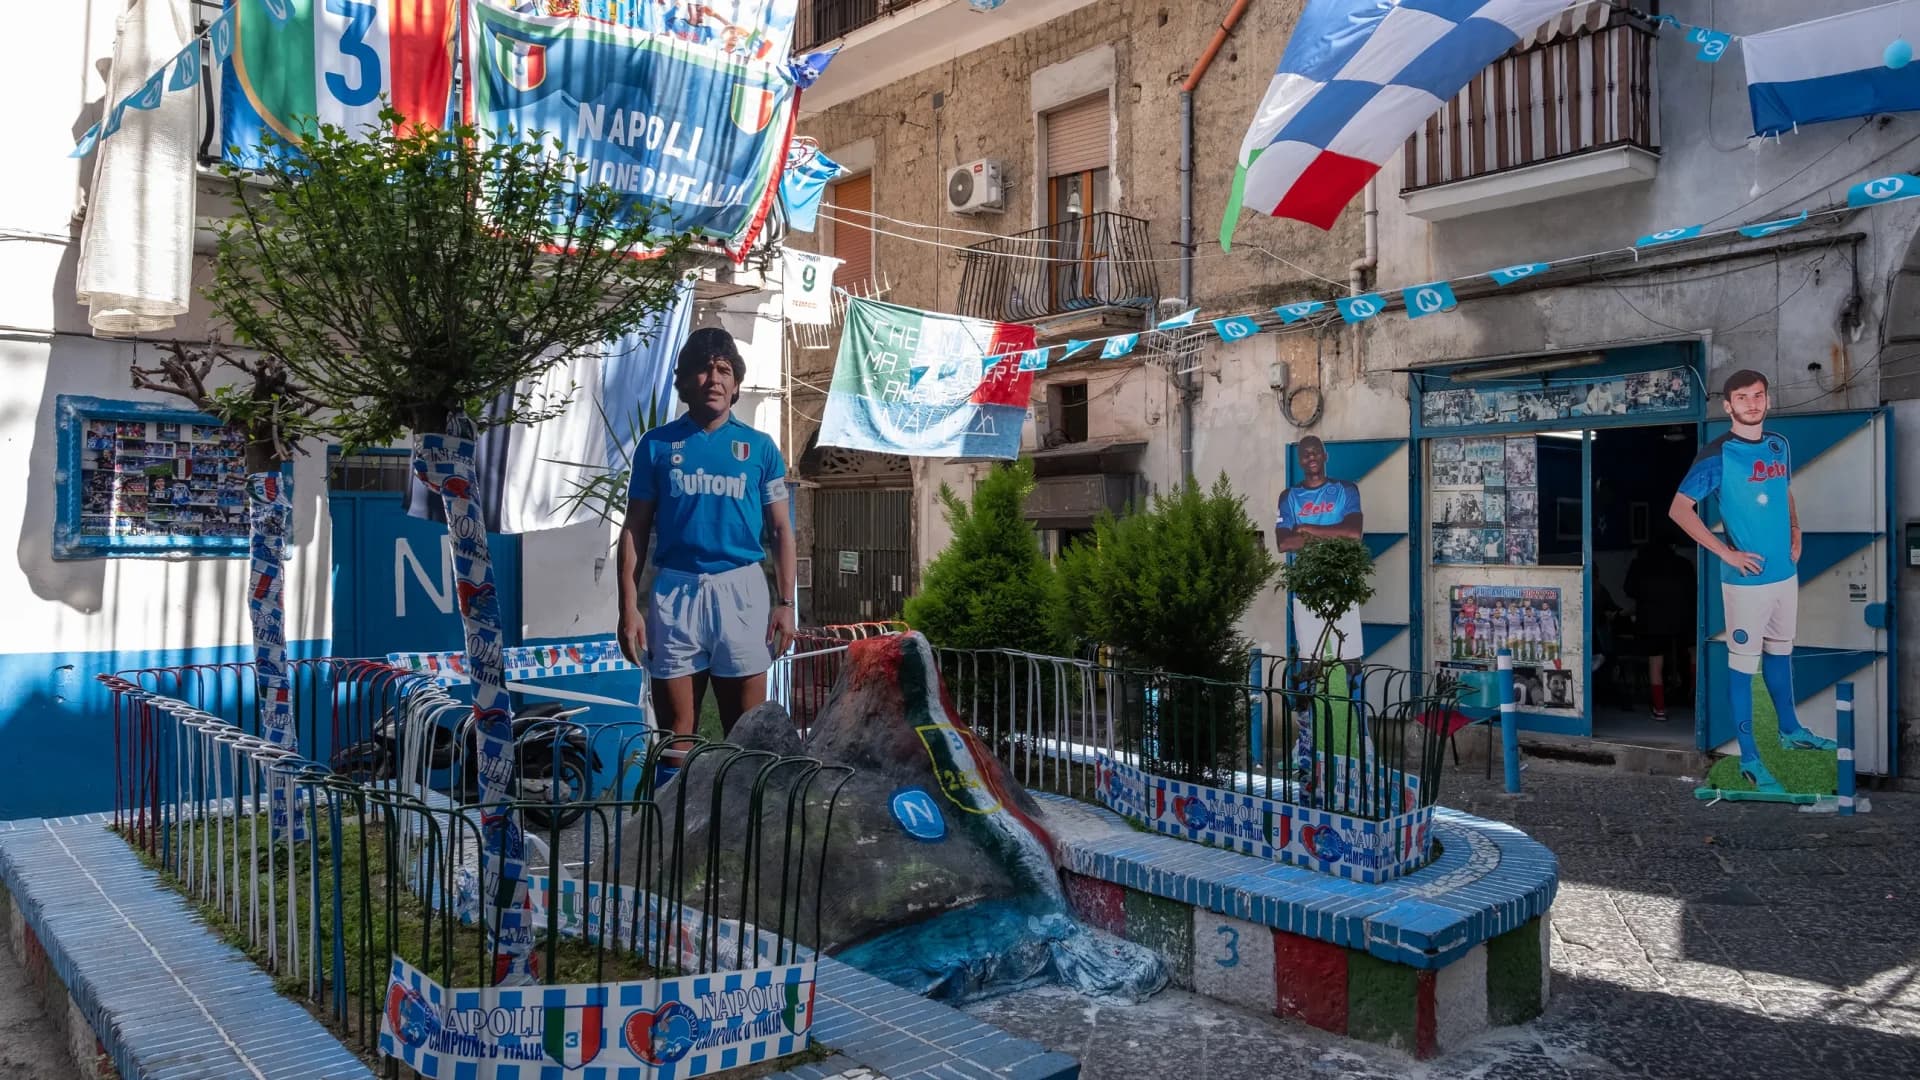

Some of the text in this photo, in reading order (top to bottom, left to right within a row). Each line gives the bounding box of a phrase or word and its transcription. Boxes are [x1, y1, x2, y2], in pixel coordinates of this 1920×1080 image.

[325, 0, 382, 107] 3
[577, 102, 704, 161] NAPOLI
[802, 265, 816, 292] 9
[1353, 301, 1373, 315] N
[1419, 290, 1439, 309] N
[872, 320, 919, 351] CHE
[1228, 323, 1246, 336] N
[864, 351, 897, 374] MA
[395, 534, 453, 617] N
[948, 731, 963, 750] 3
[902, 800, 934, 826] N
[1209, 799, 1263, 826] NAPOLI
[1208, 817, 1238, 837] CAMPIONE
[1272, 827, 1279, 836] 3
[1215, 925, 1240, 968] 3
[701, 984, 787, 1021] NAPOLI
[679, 1005, 699, 1039] NAPOLI
[428, 1030, 486, 1058] CAMPIONE
[565, 1032, 578, 1048] 3
[695, 1022, 743, 1051] CAMPIONE
